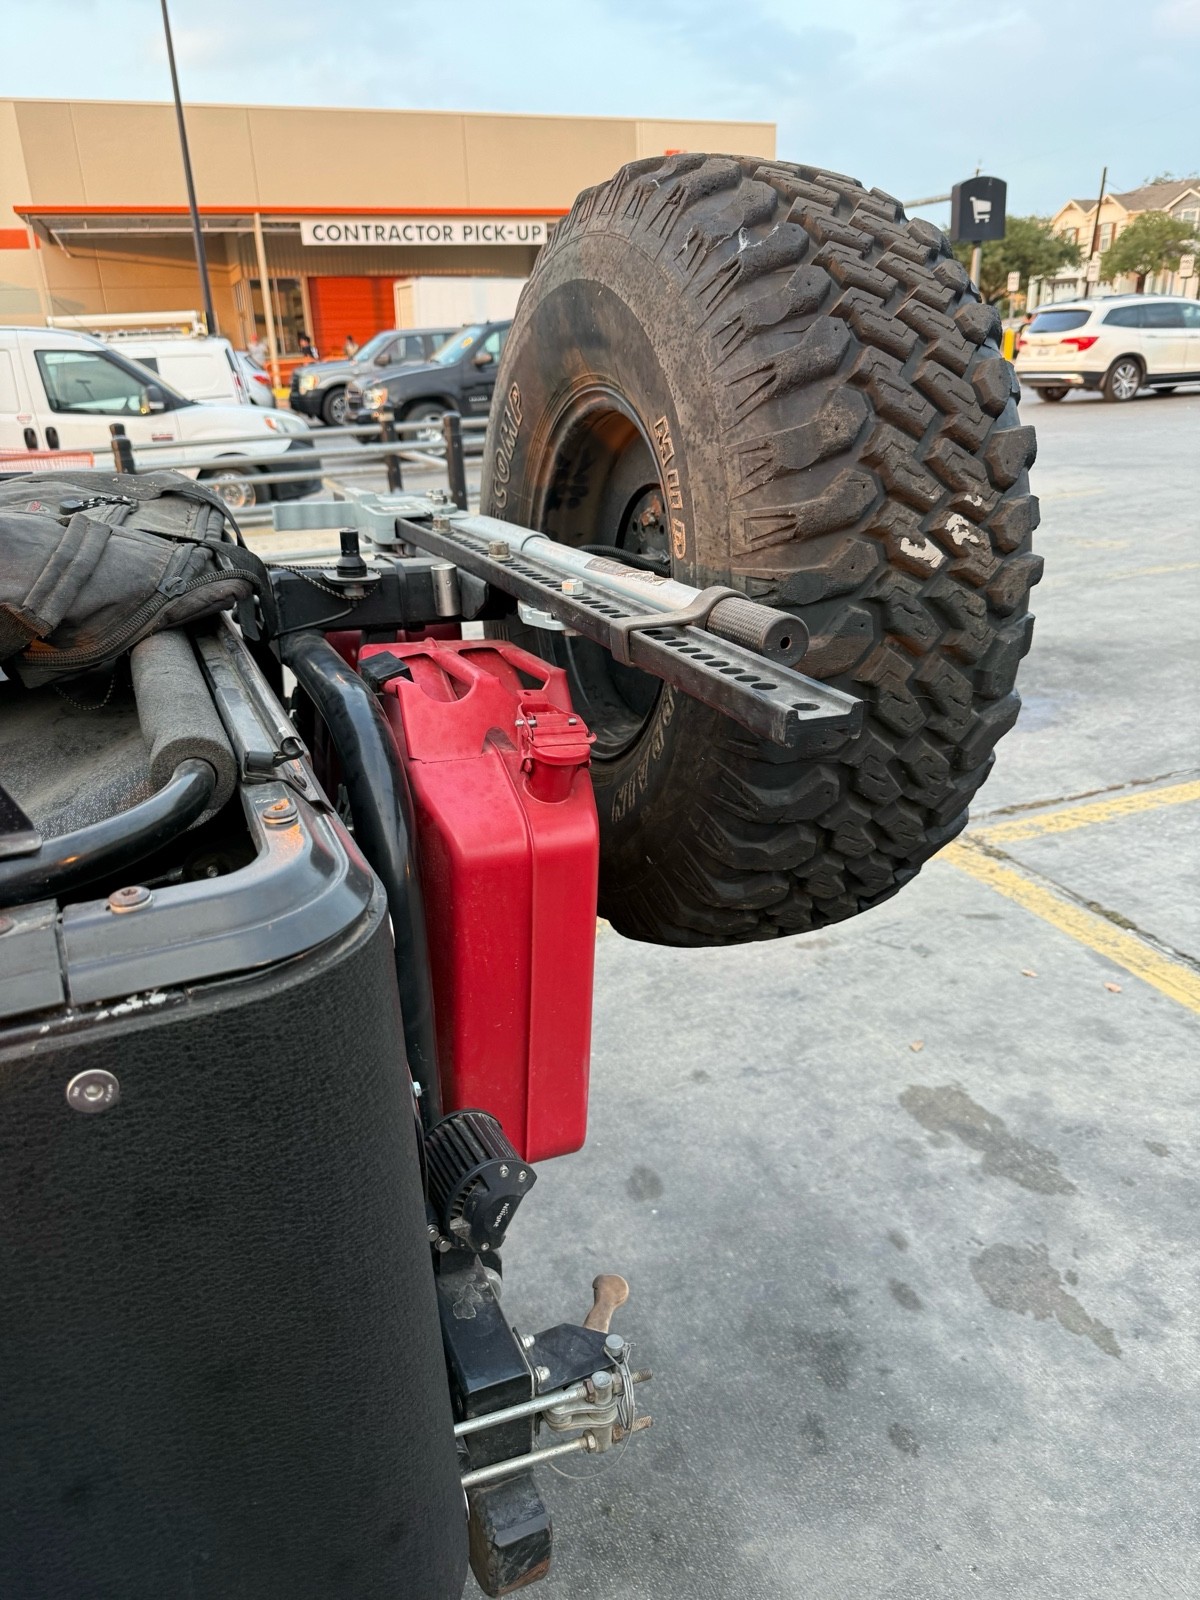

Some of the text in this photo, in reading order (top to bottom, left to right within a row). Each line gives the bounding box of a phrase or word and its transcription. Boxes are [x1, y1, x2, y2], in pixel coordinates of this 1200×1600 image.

[312, 224, 542, 242] CONTRACTOR PICK-UP
[493, 381, 524, 512] COMP
[653, 415, 687, 561] MUD
